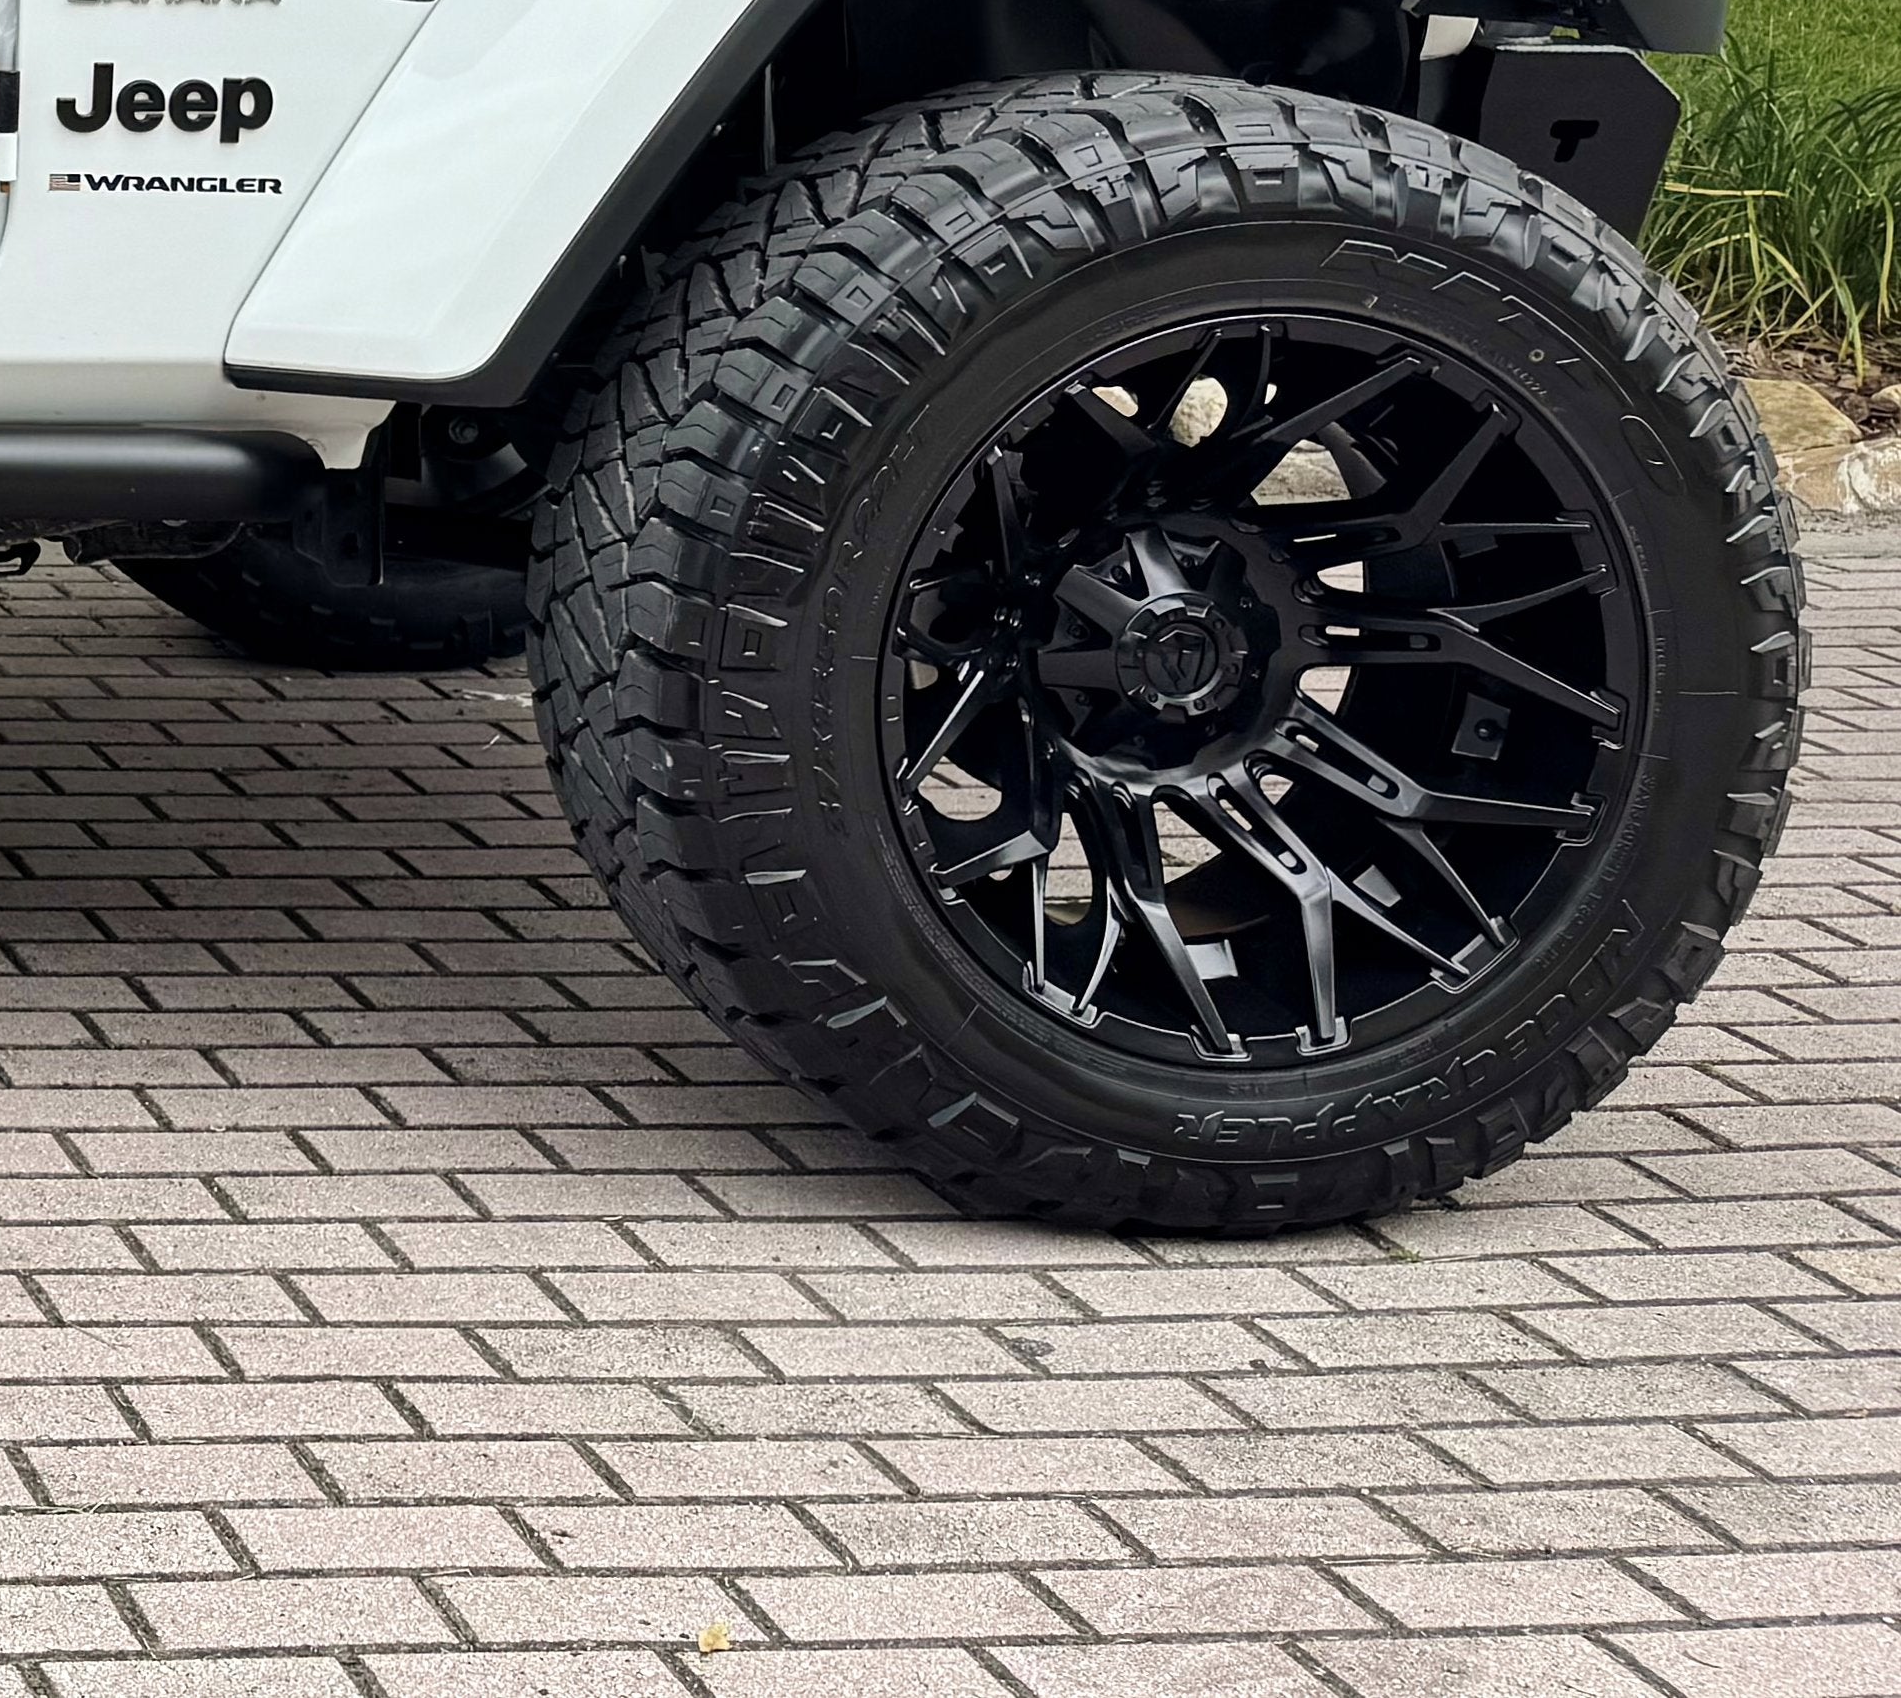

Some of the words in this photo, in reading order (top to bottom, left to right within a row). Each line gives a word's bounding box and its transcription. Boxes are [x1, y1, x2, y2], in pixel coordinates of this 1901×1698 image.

[56, 62, 274, 143] Jeep
[84, 173, 283, 195] WRANGLER
[1172, 1047, 1499, 1146] GRAPPLER
